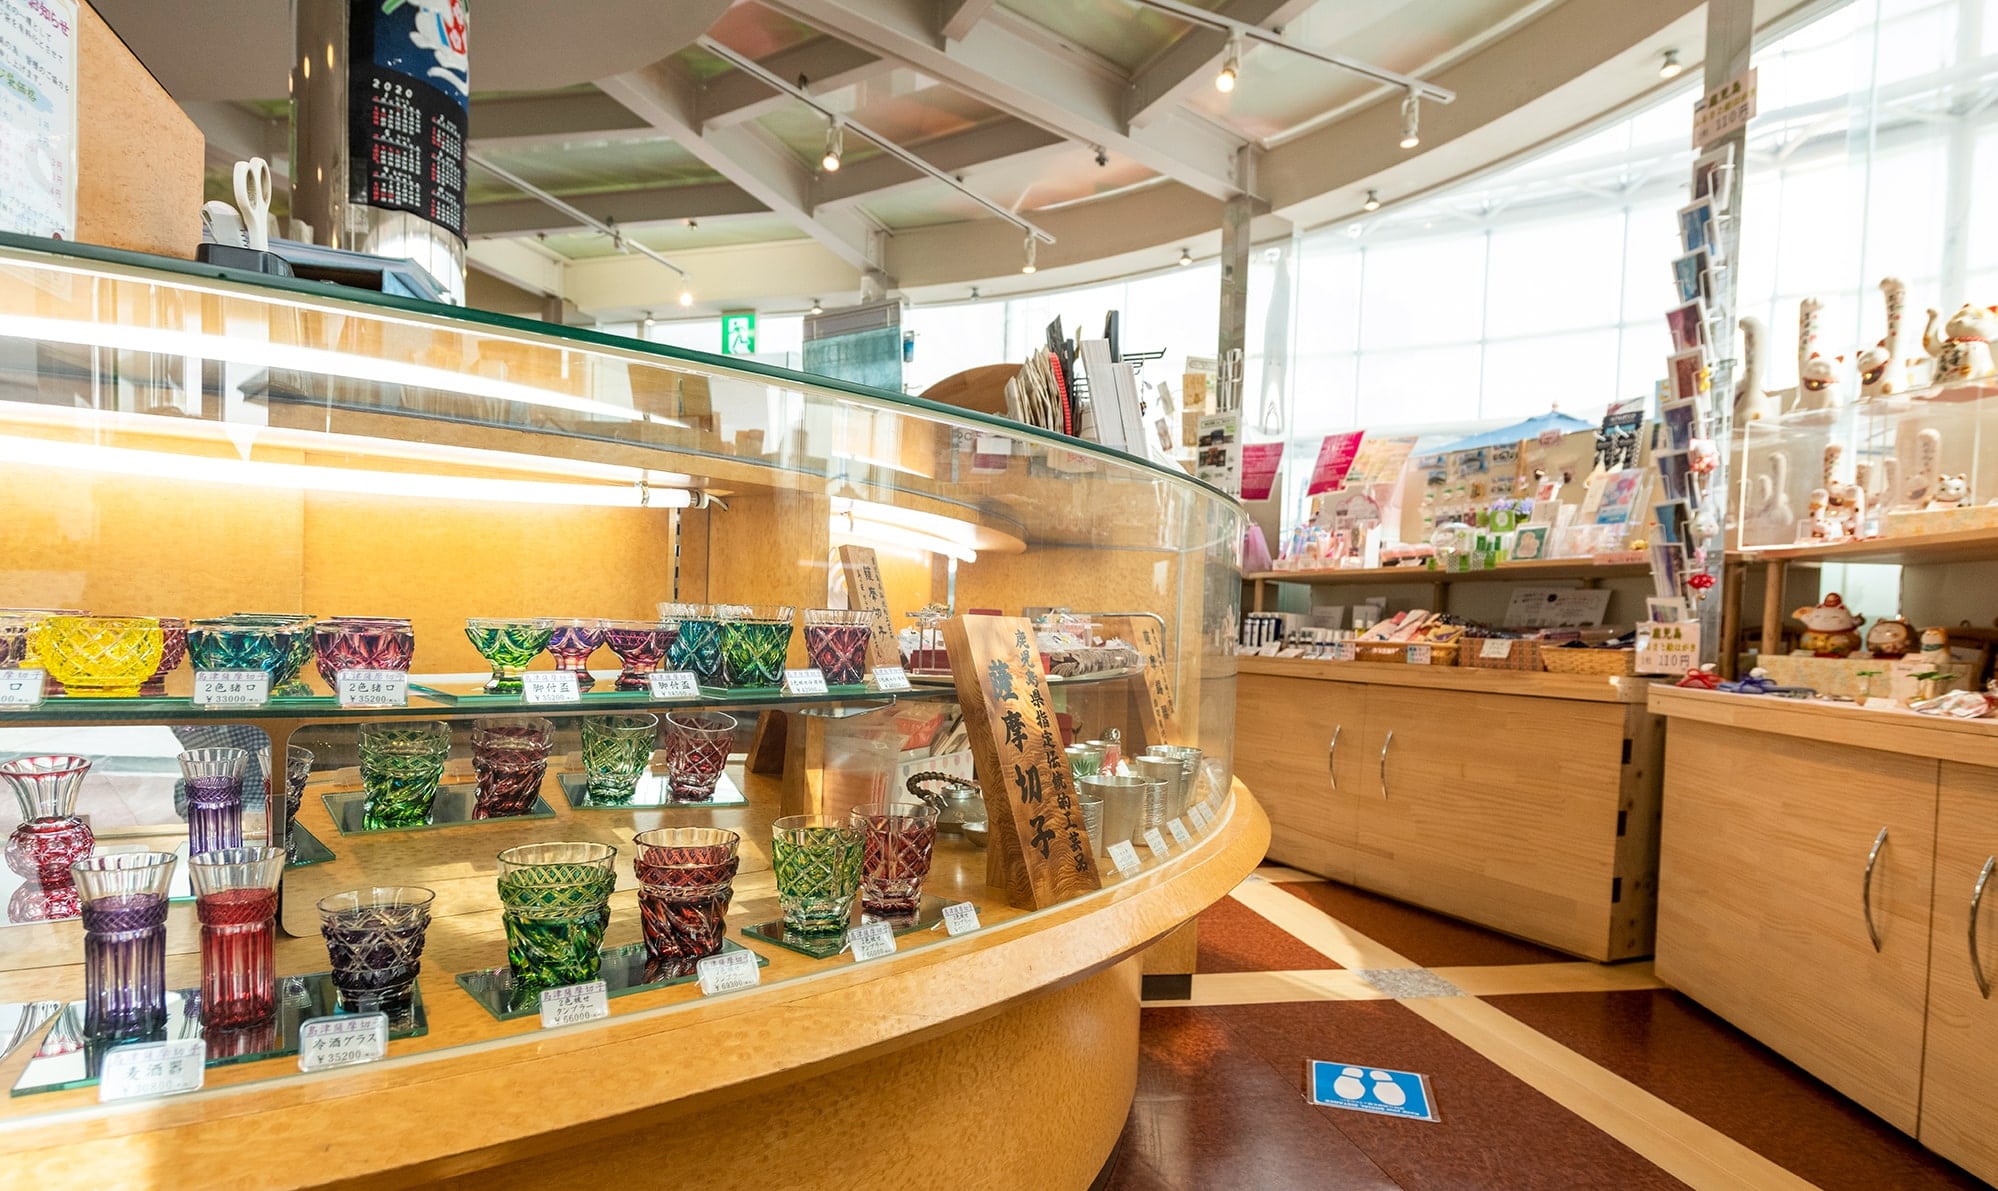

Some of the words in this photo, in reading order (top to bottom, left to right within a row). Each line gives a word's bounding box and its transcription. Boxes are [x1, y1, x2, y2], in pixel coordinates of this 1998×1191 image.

[372, 78, 413, 98] 2020
[1658, 654, 1690, 670] 110円
[988, 658, 1056, 859] 薩摩切子
[1014, 628, 1089, 873] 鹿児島県指定伝統的工芸品
[313, 1033, 377, 1050] 冷酒グラス
